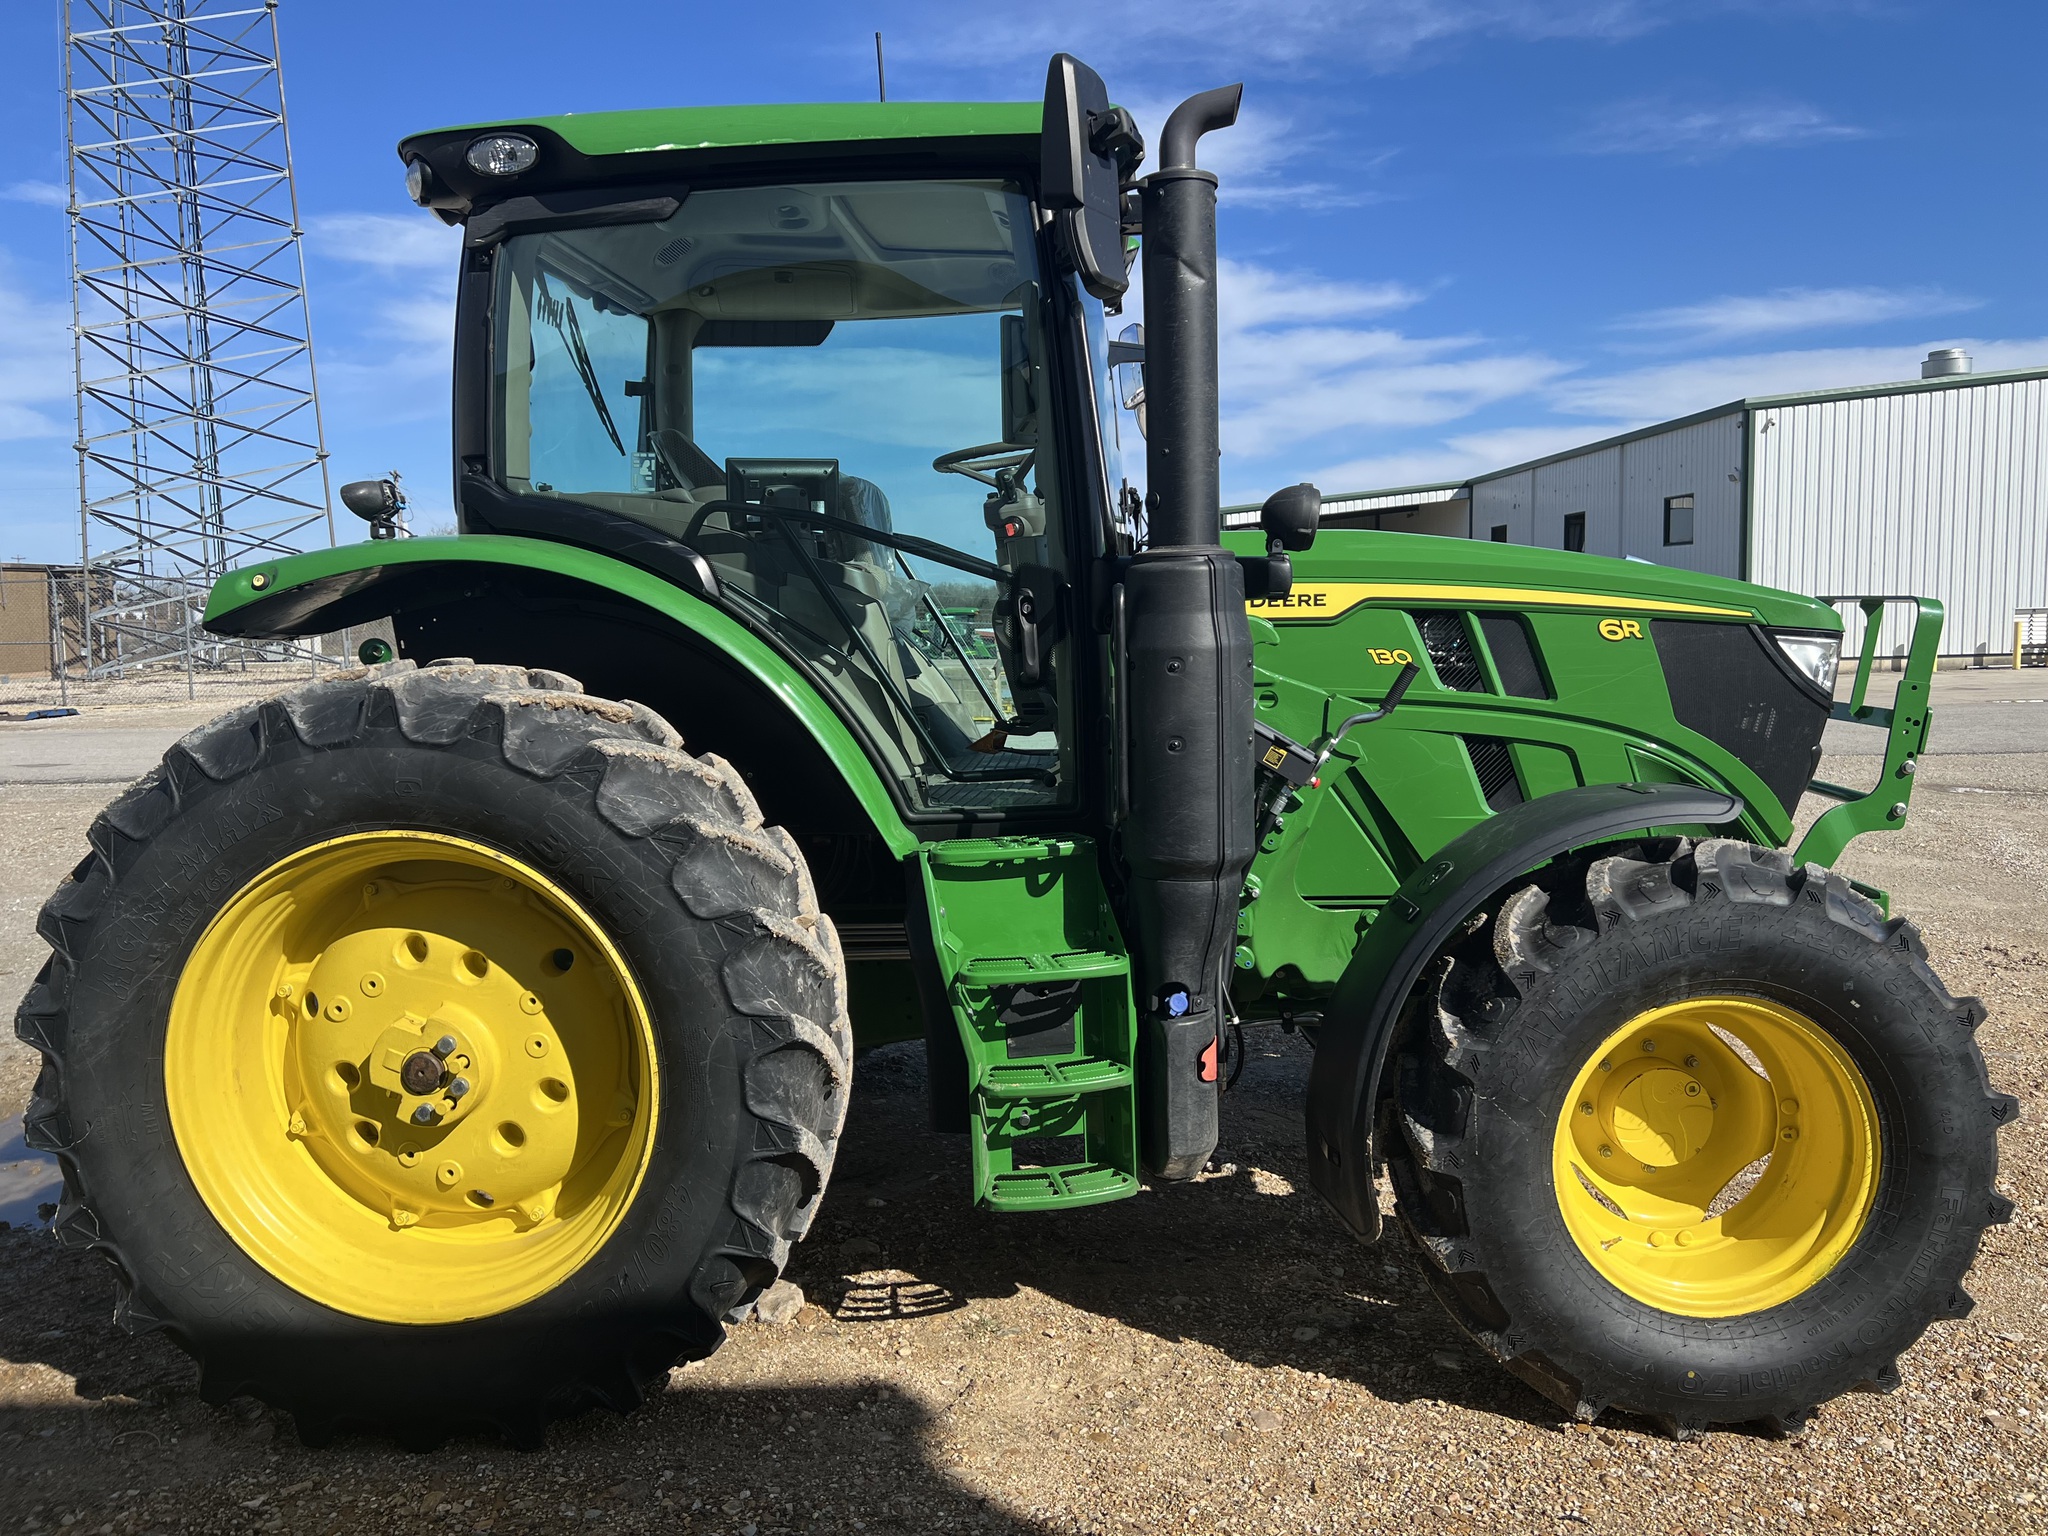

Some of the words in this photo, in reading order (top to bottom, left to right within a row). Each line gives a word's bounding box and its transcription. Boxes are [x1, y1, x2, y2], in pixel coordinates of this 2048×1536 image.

[1250, 593, 1327, 608] DEERE
[1597, 618, 1644, 642] 6R
[1366, 648, 1413, 665] 130
[194, 863, 233, 901] 765
[519, 813, 655, 934] BKT
[1518, 916, 1743, 1066] ALLIANCE
[1677, 1369, 1728, 1397] 70
[1739, 1340, 1853, 1397] Radial
